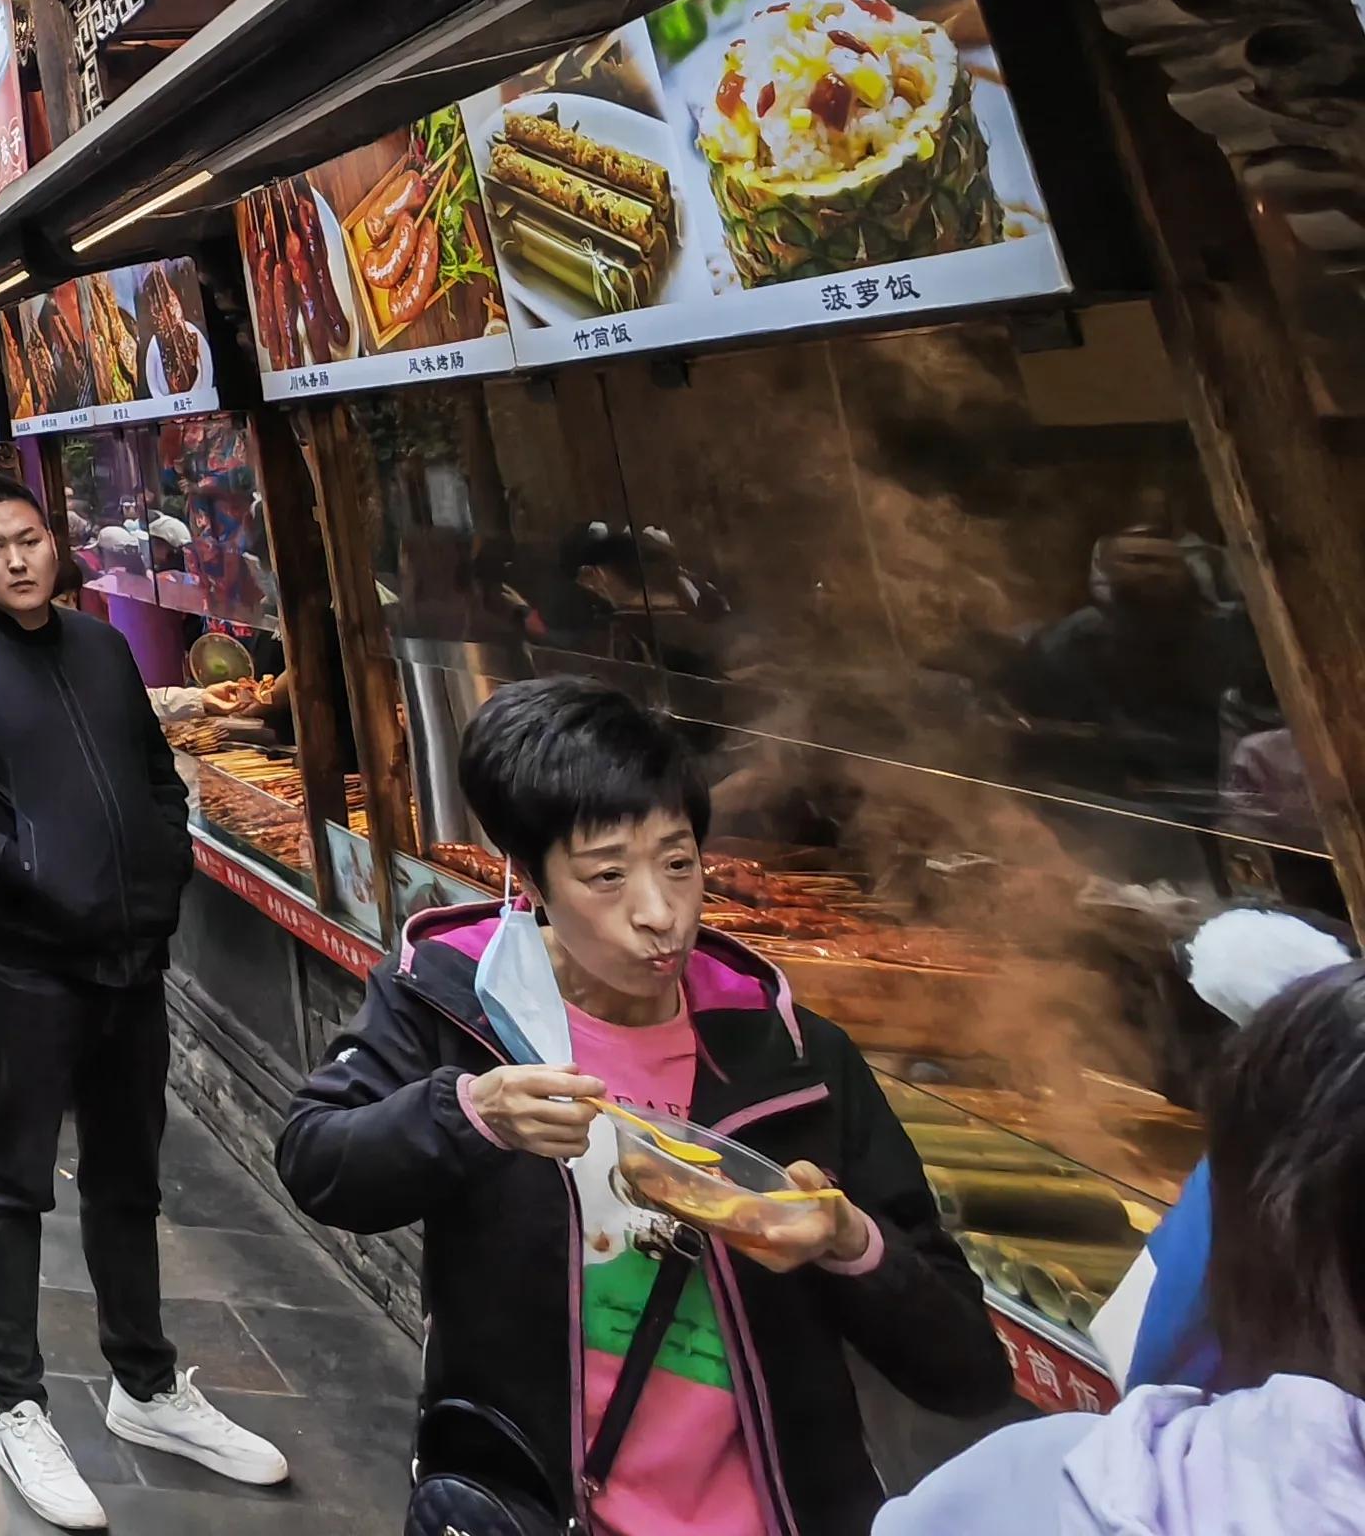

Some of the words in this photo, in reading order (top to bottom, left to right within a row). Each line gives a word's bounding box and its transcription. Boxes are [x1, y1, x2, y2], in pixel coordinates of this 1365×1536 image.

[820, 274, 921, 312] 菠萝饭
[573, 322, 632, 352] 竹筒饭
[408, 351, 464, 375] 风味烤肠
